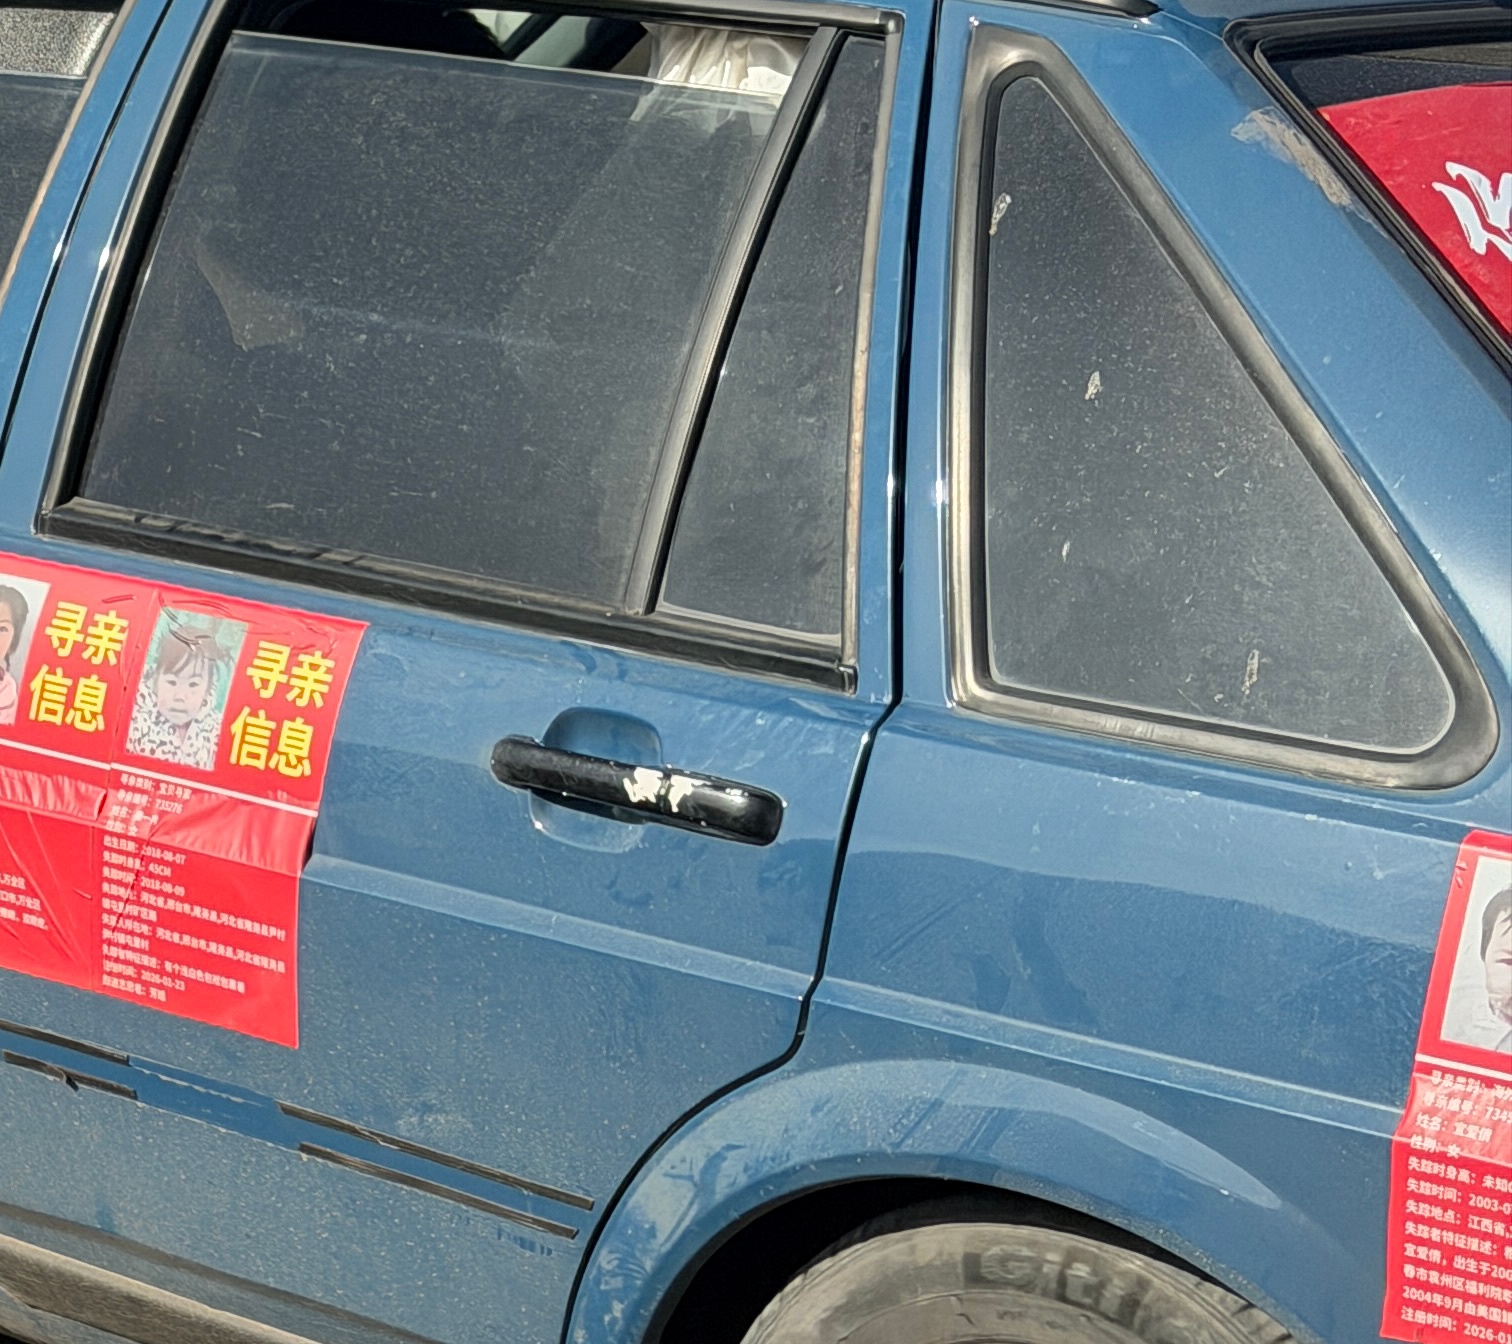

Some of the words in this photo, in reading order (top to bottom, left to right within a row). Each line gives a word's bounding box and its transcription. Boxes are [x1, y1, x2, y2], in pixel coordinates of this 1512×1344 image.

[44, 601, 128, 666] 寻亲
[28, 664, 108, 733] 信息
[246, 640, 334, 708] 寻亲
[229, 706, 314, 778] 信息
[1405, 1198, 1512, 1238] 失踪地点：江西省,
[1406, 1174, 1512, 1214] 失踪时间：2003-0
